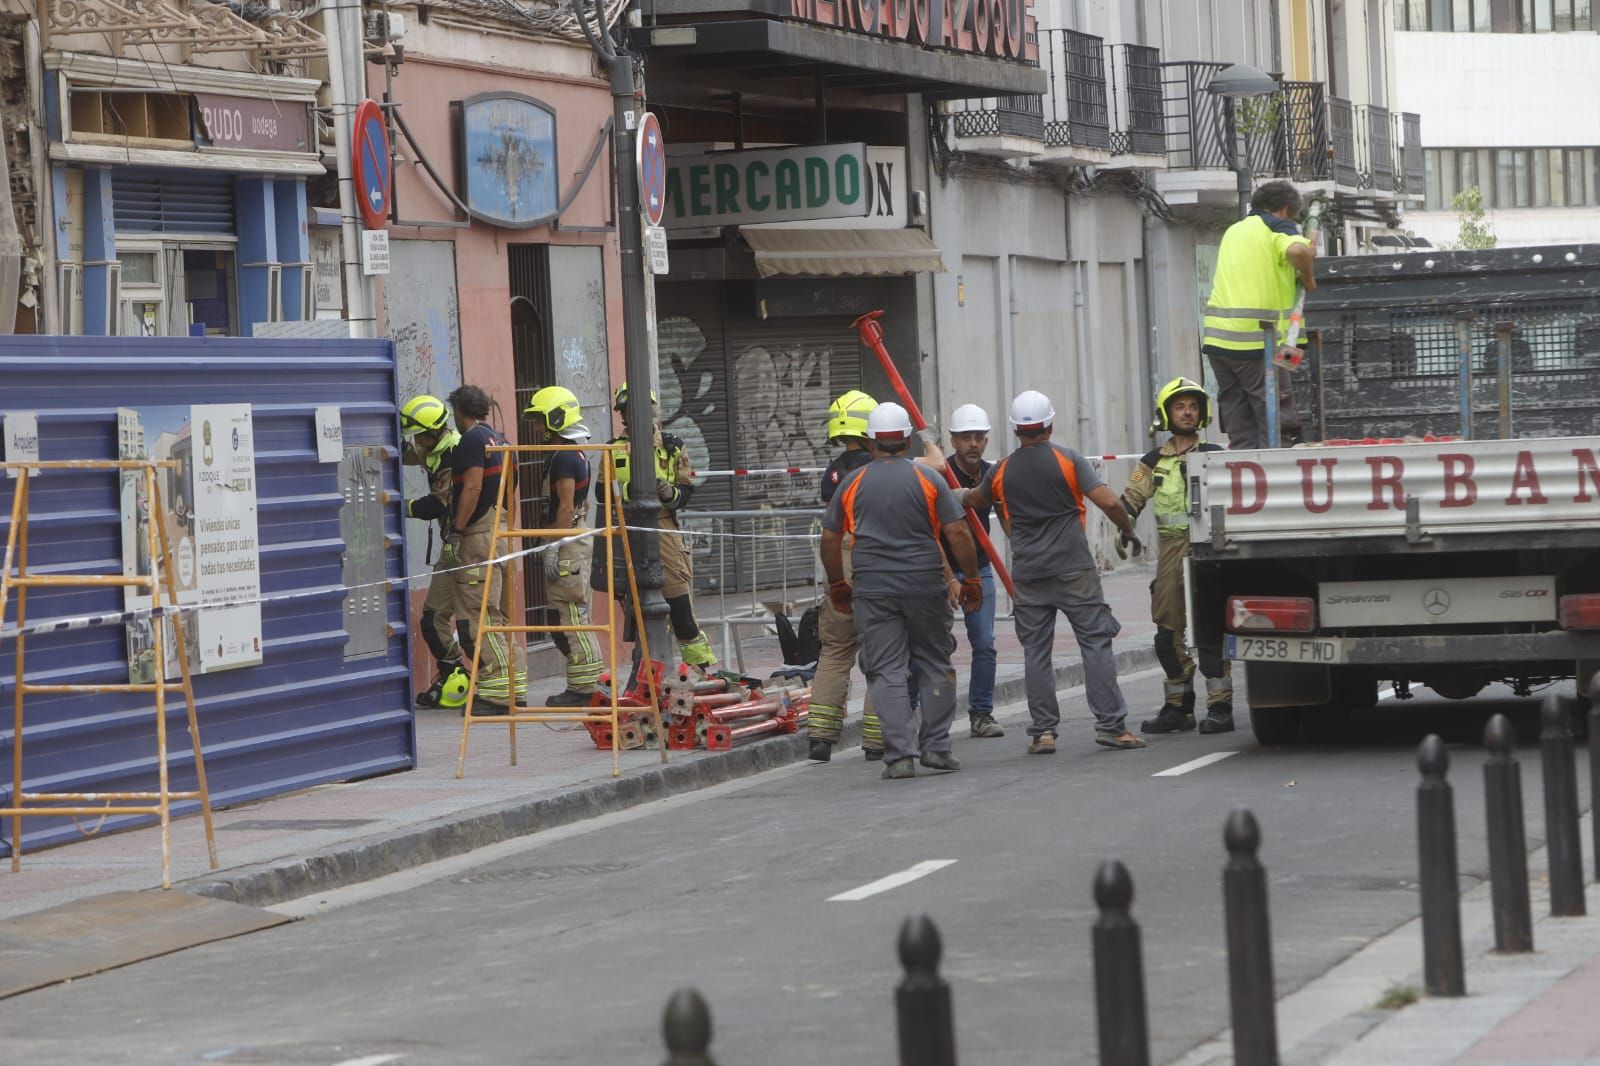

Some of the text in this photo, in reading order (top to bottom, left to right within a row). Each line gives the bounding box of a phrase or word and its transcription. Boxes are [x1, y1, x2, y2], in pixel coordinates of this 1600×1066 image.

[943, 0, 1039, 61] AZOQUE
[252, 115, 278, 139] bodega
[664, 154, 861, 219] MERCADO
[200, 516, 240, 532] Viviendas únicas
[201, 536, 254, 557] pensadas para cubrir
[201, 561, 216, 575] todas
[217, 561, 225, 574] tus
[226, 557, 255, 572] necesidades
[1242, 639, 1289, 658] 7358
[1300, 641, 1335, 661] FWD
